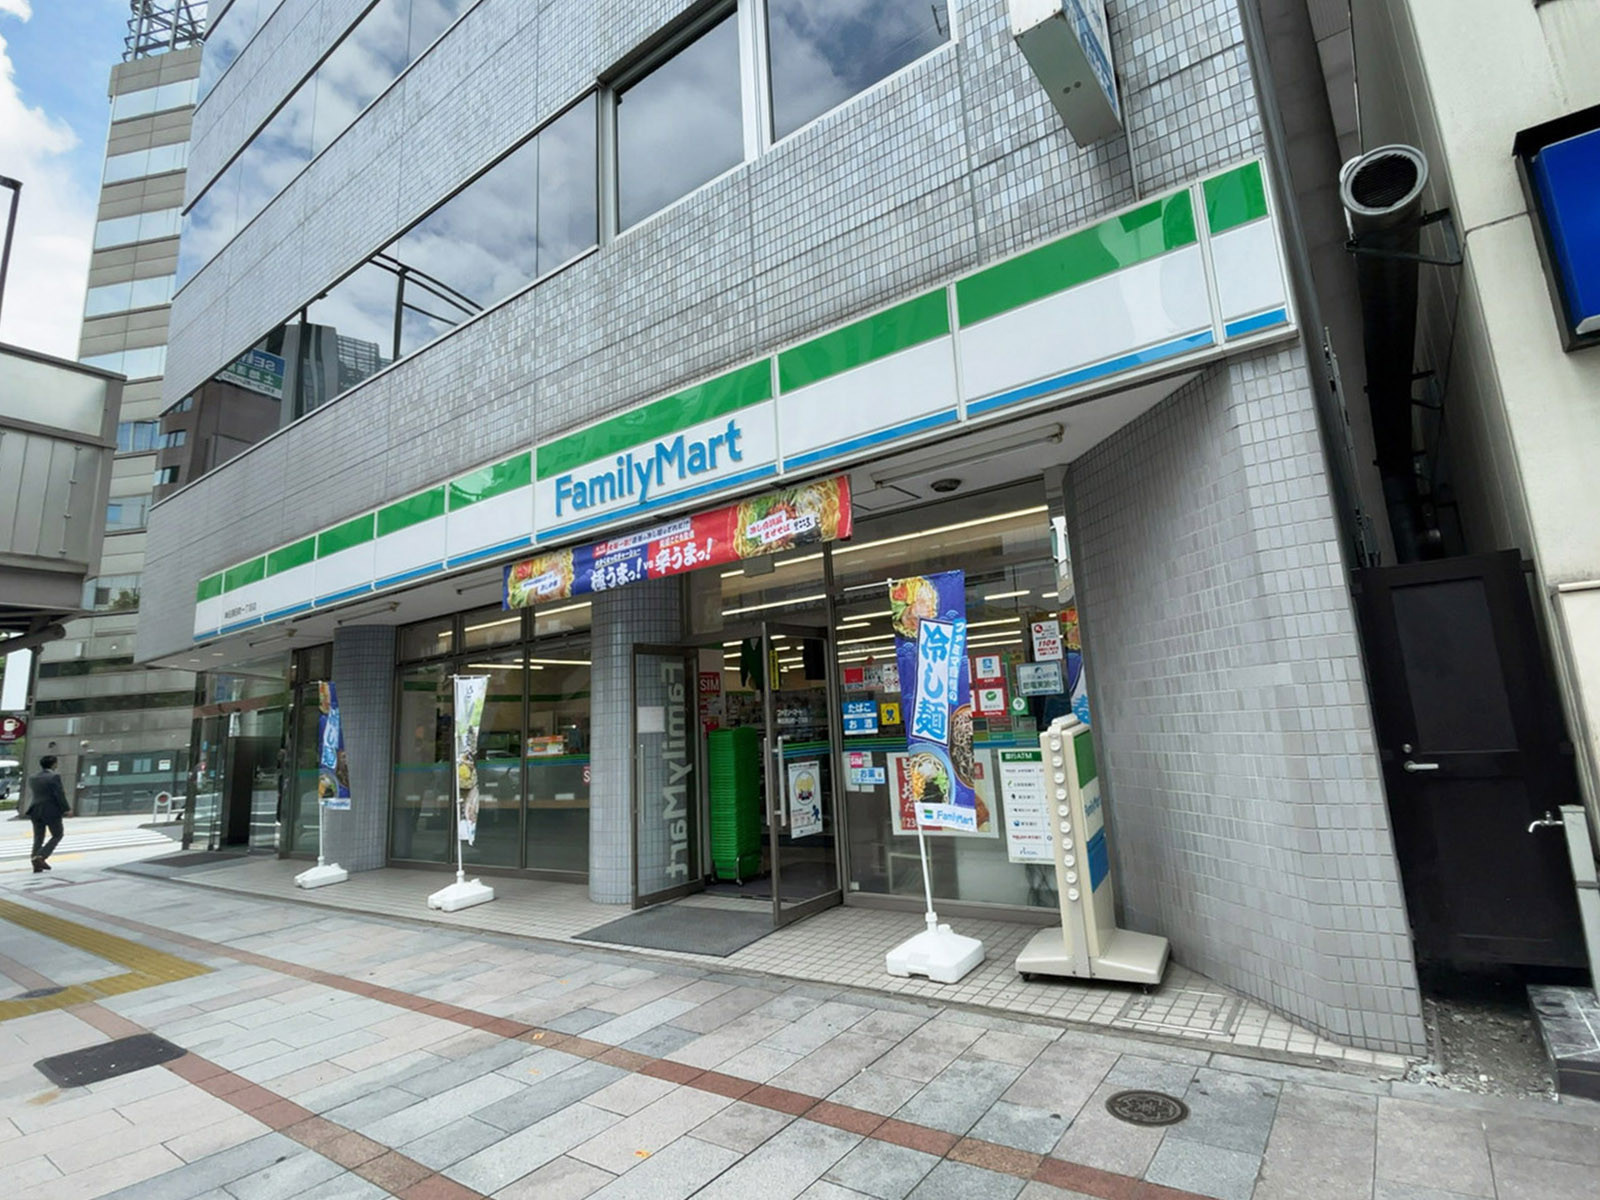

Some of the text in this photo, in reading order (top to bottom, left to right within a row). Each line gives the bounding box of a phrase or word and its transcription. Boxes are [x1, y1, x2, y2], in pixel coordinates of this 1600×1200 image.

[555, 419, 742, 516] FamilyMart
[701, 678, 720, 691] SIM
[915, 623, 951, 740] 冷し麺
[848, 702, 872, 713] たばこ
[936, 810, 974, 826] FamilyMart
